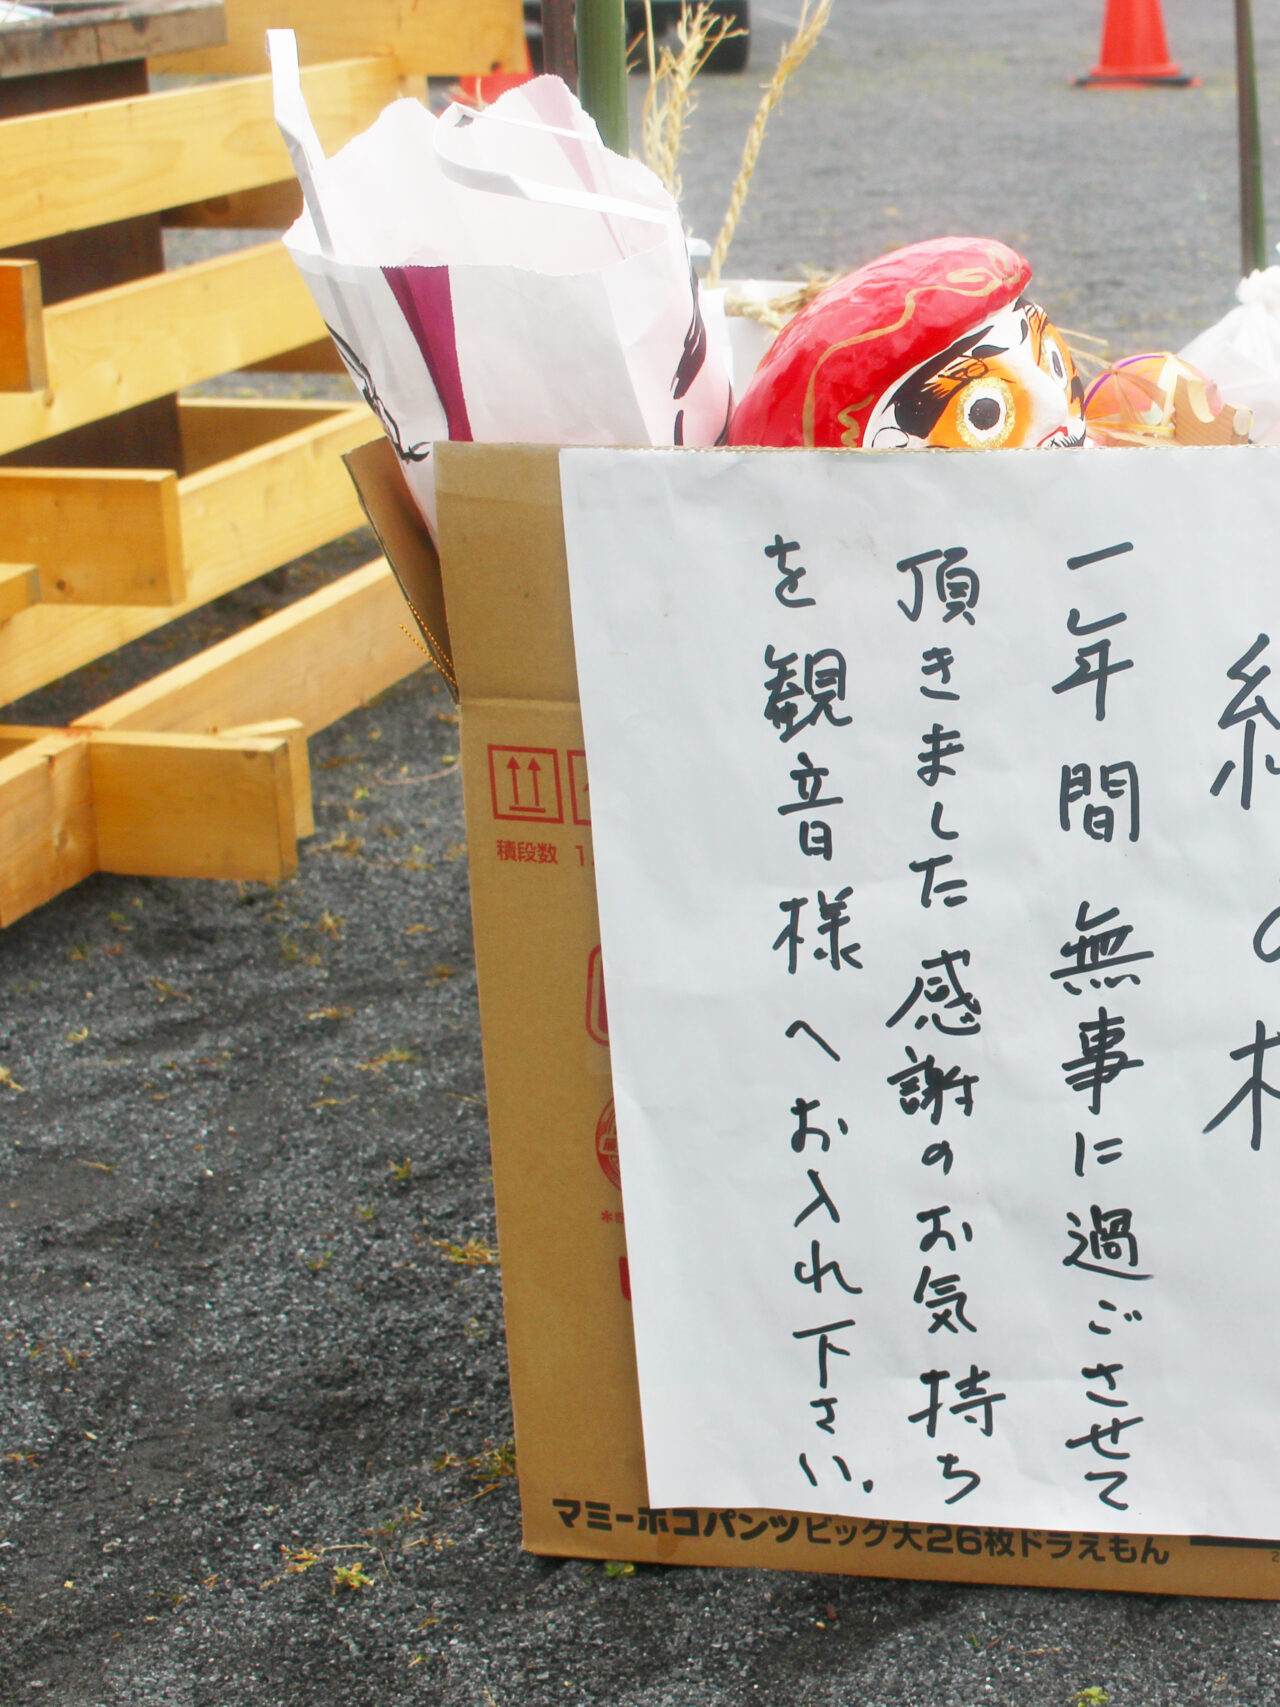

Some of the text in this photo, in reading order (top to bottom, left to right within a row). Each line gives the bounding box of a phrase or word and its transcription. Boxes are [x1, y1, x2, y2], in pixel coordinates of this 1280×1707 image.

[496, 839, 558, 865] 積段数
[885, 546, 1006, 1505] 頂きました感謝のお気持ち
[1050, 541, 1155, 1511] 一年間無事に過ごさせて
